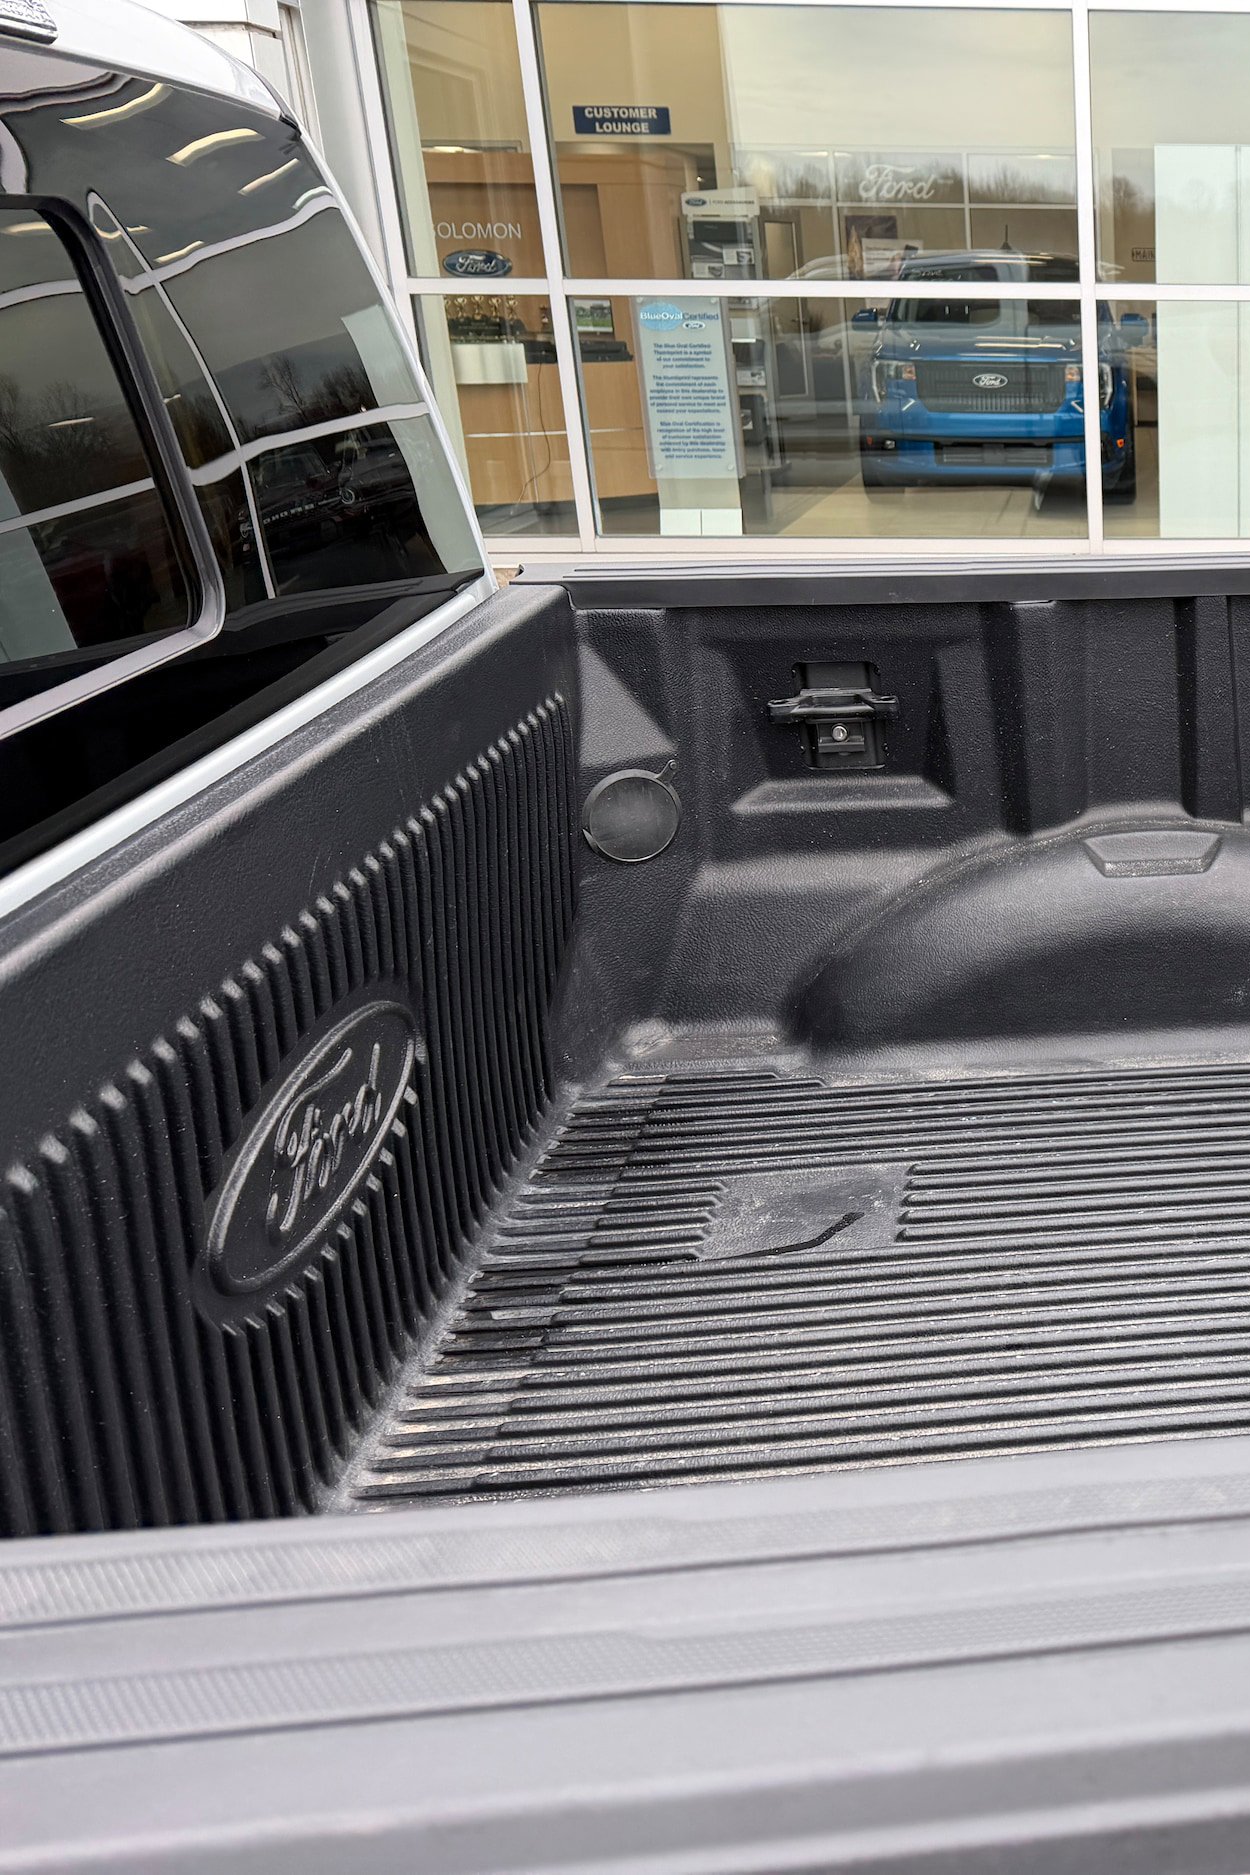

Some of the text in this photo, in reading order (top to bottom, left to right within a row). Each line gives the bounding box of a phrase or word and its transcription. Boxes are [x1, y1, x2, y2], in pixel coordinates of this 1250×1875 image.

[584, 107, 657, 119] CUSTOMER
[595, 121, 650, 133] LOUNGE
[858, 163, 936, 200] Ford
[433, 221, 521, 239] OLOMON
[456, 254, 497, 273] Ford
[265, 1041, 383, 1233] Ford
